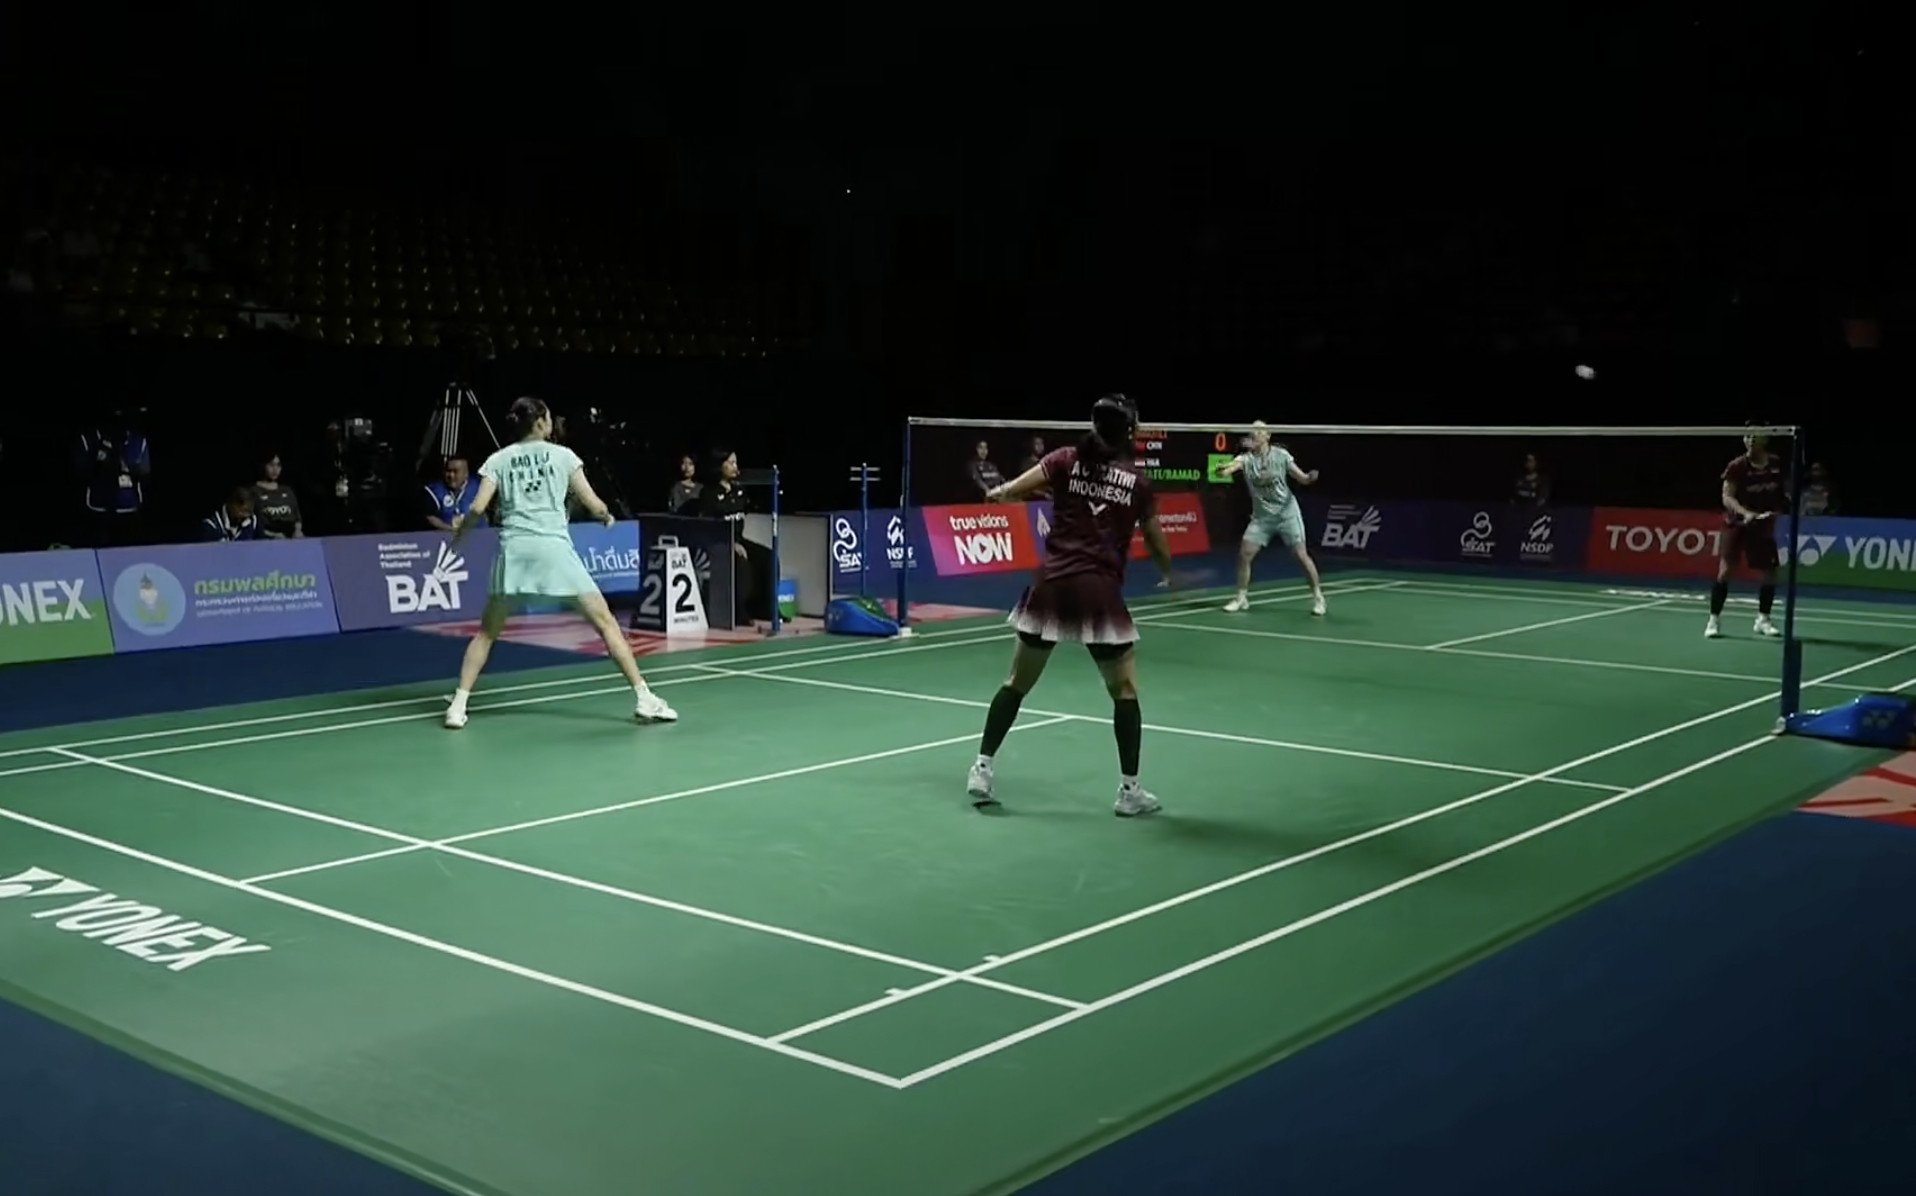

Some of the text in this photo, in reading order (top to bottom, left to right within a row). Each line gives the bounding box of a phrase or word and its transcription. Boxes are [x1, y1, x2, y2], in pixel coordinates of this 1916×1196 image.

[1215, 432, 1226, 451] 0
[1071, 460, 1080, 477] A
[1069, 478, 1131, 506] INDONESIA
[954, 532, 1013, 566] NOW
[1321, 522, 1380, 550] BAT
[0, 578, 92, 626] NEX
[384, 570, 469, 614] BAT
[640, 573, 663, 615] 2
[672, 573, 696, 614] 2
[31, 893, 272, 972] YONEX
